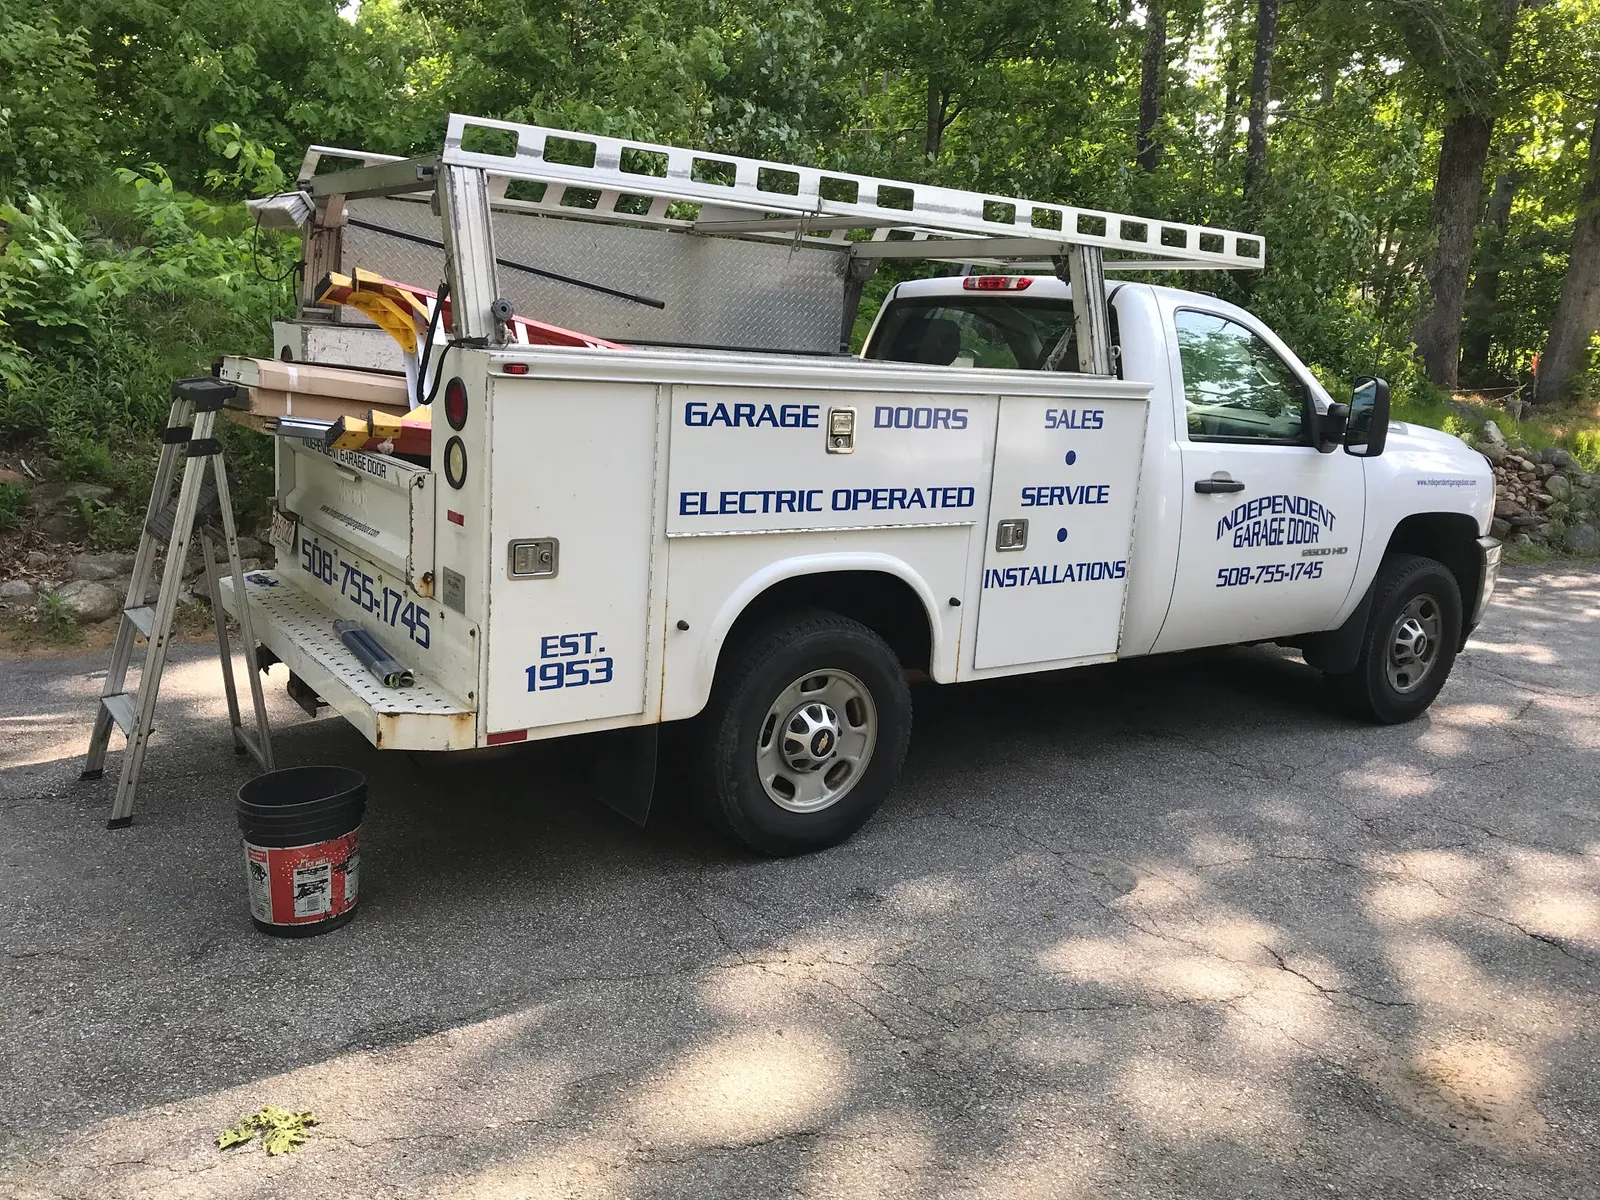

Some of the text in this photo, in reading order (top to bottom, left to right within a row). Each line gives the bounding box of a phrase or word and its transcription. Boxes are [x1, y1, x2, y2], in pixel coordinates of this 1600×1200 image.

[684, 402, 820, 428] GARAGE
[873, 406, 969, 430] DOORS
[1045, 409, 1104, 430] SALES
[340, 450, 366, 471] GARAGE
[367, 458, 387, 479] DOOR
[679, 486, 975, 516] ELECTRIC OPERATED
[1021, 485, 1110, 507] SERVICE
[1216, 494, 1336, 541] INDEPENDENT
[1233, 517, 1320, 548] GARAGE DOOR
[1332, 547, 1348, 555] HD
[984, 560, 1127, 589] INSTALLATIONS
[1216, 561, 1324, 588] 508-755-1745
[301, 537, 431, 650] 508-755-1745
[540, 631, 605, 659] EST.
[525, 657, 613, 692] 1953
